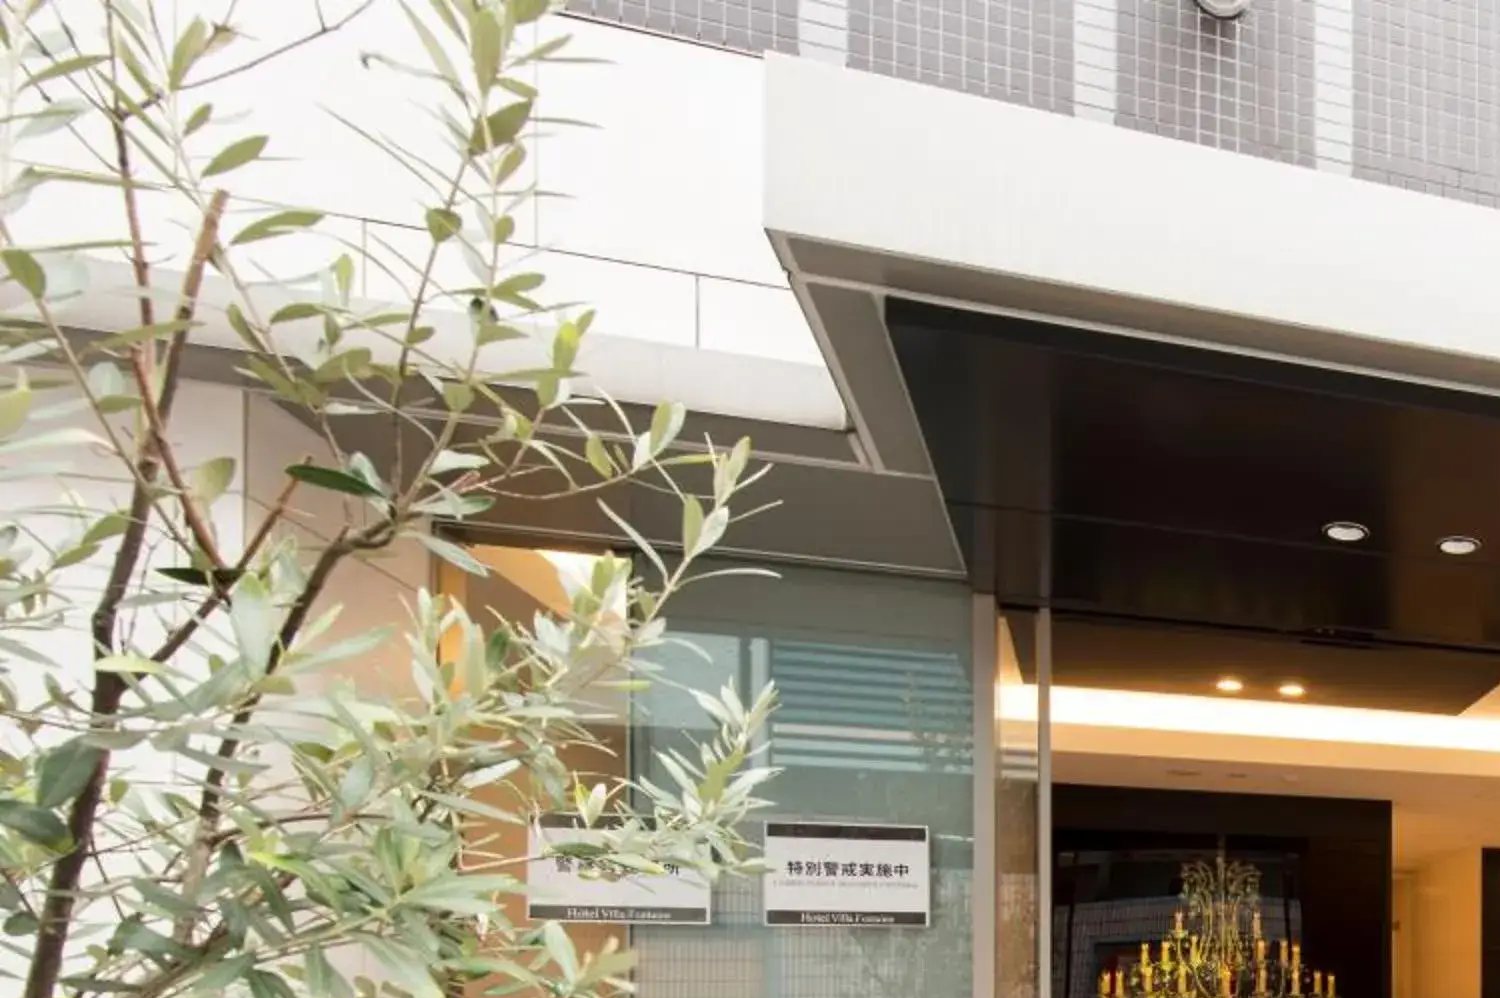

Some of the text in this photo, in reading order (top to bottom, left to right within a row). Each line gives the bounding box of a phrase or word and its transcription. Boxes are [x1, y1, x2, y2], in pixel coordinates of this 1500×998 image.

[567, 907, 599, 919] Hotel
[801, 911, 829, 924] Hotel
[830, 911, 854, 924] Villa
